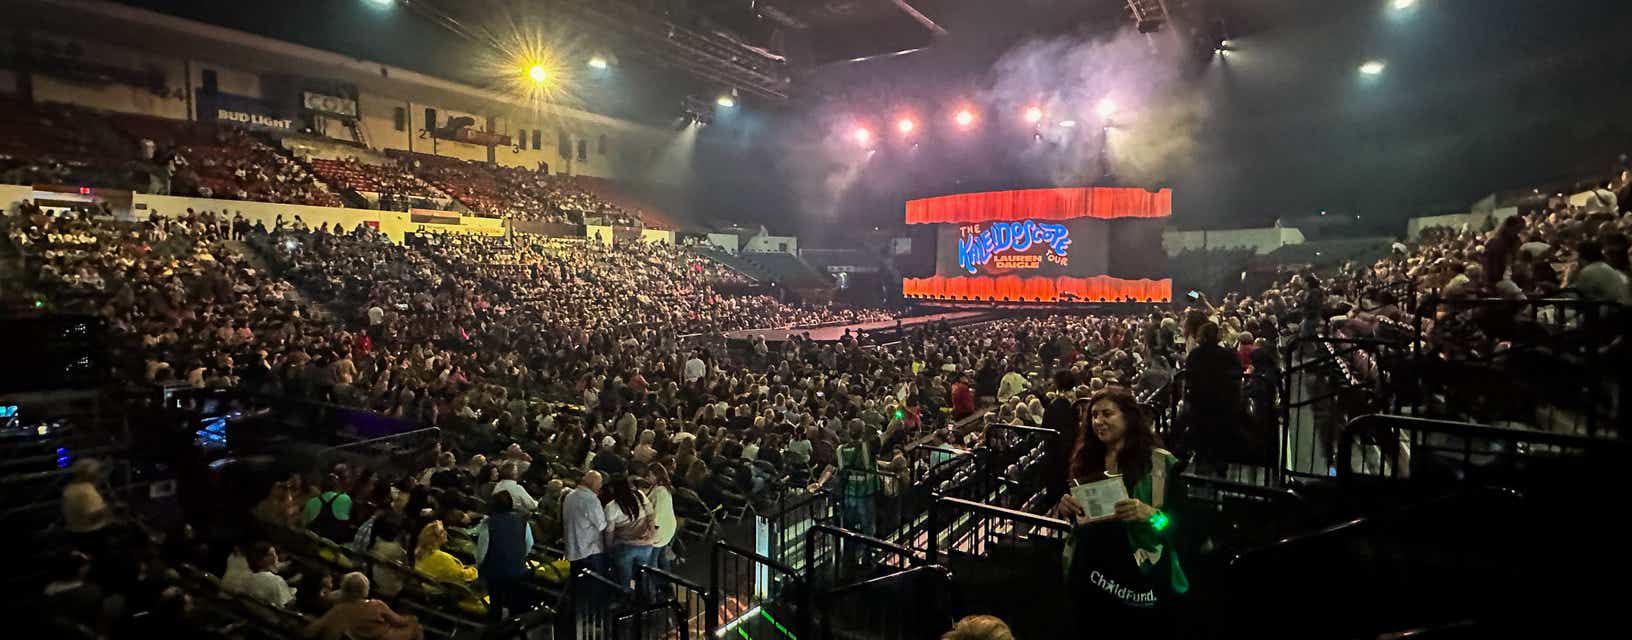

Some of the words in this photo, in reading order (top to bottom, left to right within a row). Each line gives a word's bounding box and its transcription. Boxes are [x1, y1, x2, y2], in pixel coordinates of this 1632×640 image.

[218, 109, 250, 123] BUD
[251, 114, 292, 129] LIGHT
[960, 224, 981, 237] THE
[959, 220, 1072, 274] KALEIDOSCOPE
[1045, 250, 1068, 266] TOUR
